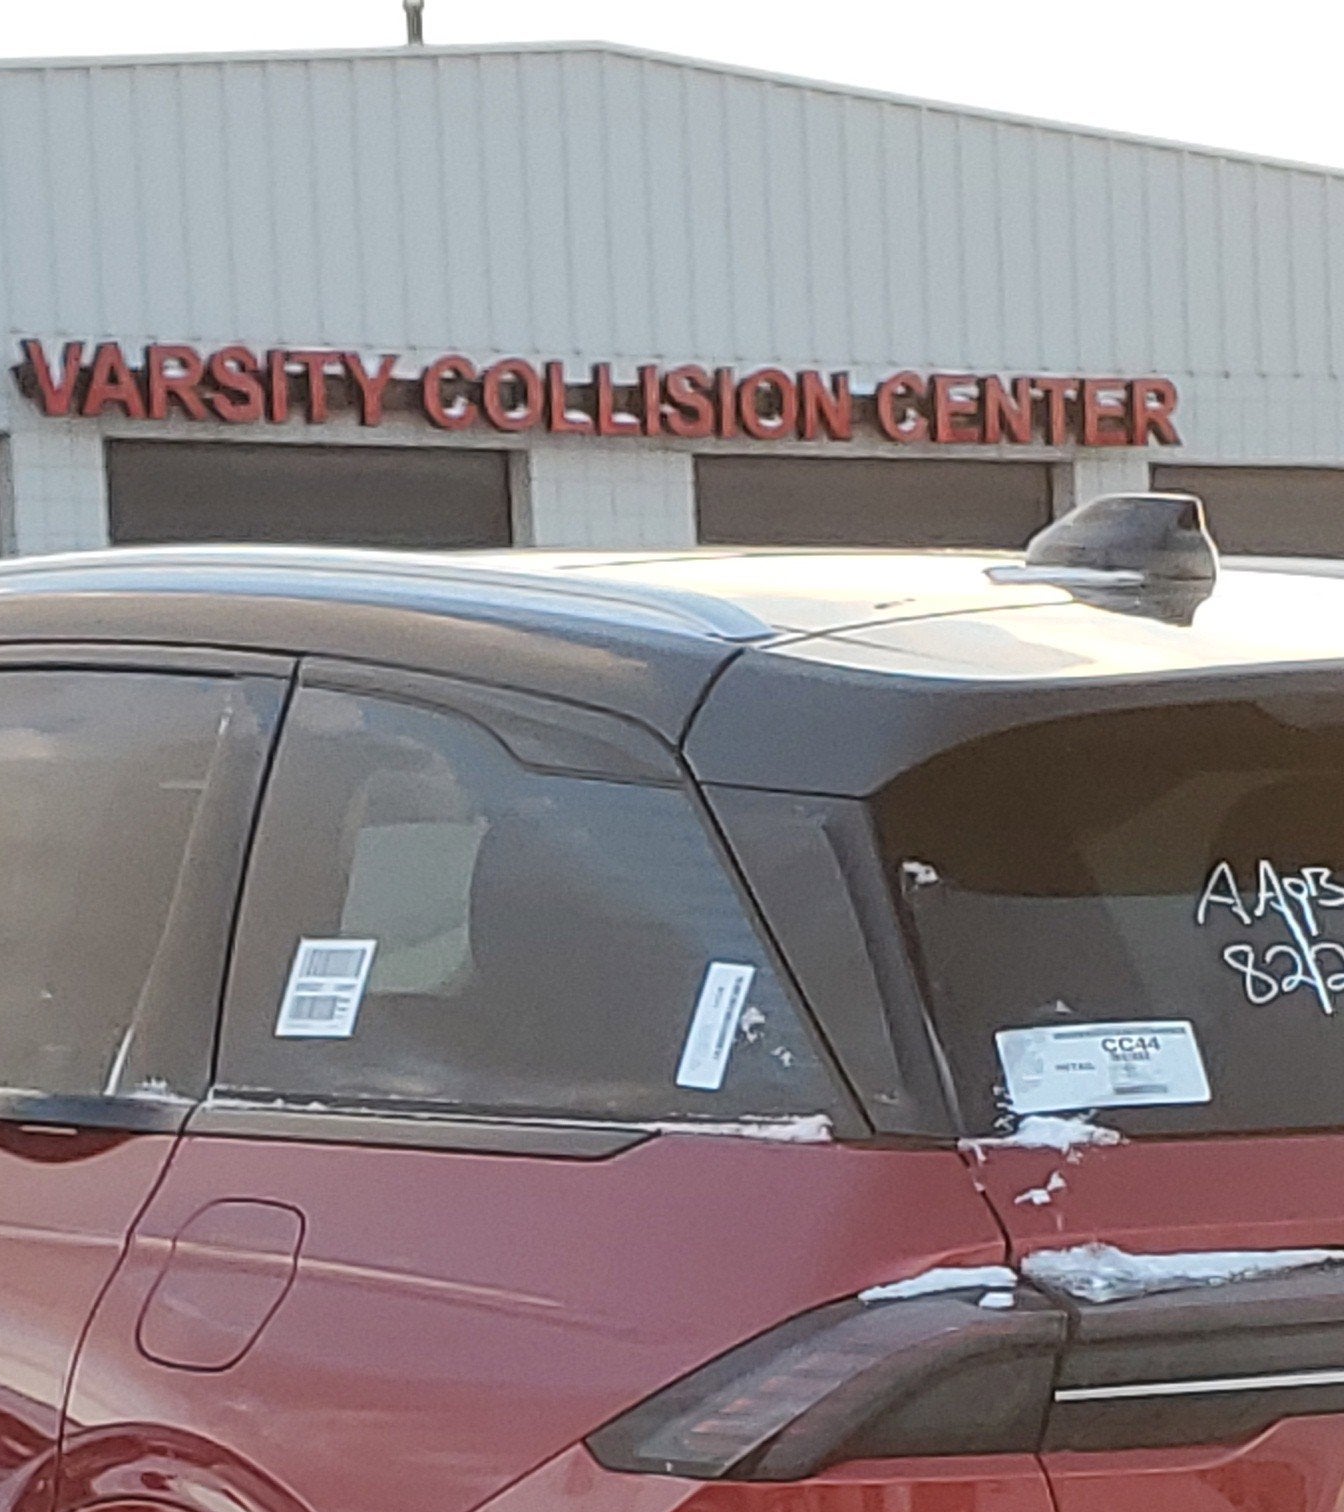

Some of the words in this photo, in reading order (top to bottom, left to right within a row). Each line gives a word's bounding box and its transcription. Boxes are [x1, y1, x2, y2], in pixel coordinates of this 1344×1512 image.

[20, 338, 399, 428] VARSITY
[422, 353, 853, 440] COLLISION
[875, 369, 1184, 447] CENTER
